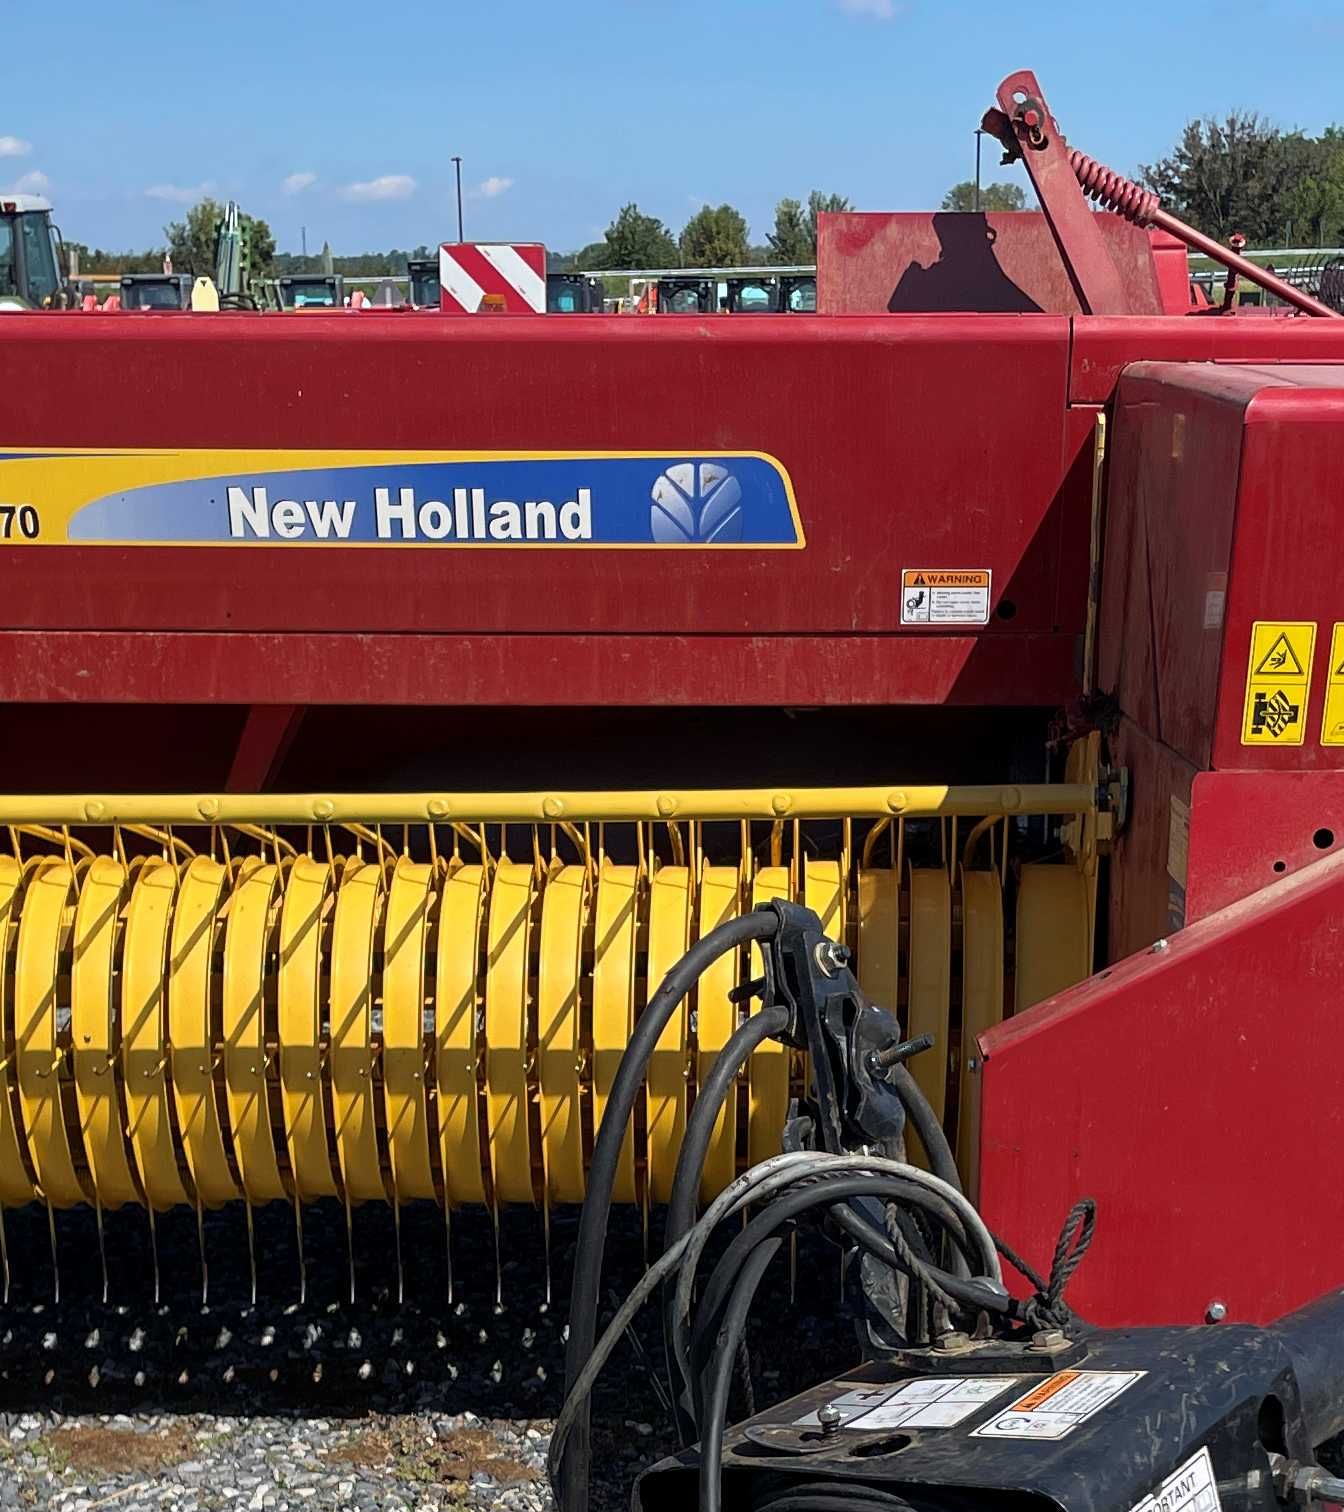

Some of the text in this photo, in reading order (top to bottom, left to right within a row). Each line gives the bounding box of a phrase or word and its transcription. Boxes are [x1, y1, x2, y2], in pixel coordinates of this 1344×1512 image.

[226, 487, 592, 539] New Holland
[927, 574, 982, 584] WARNING
